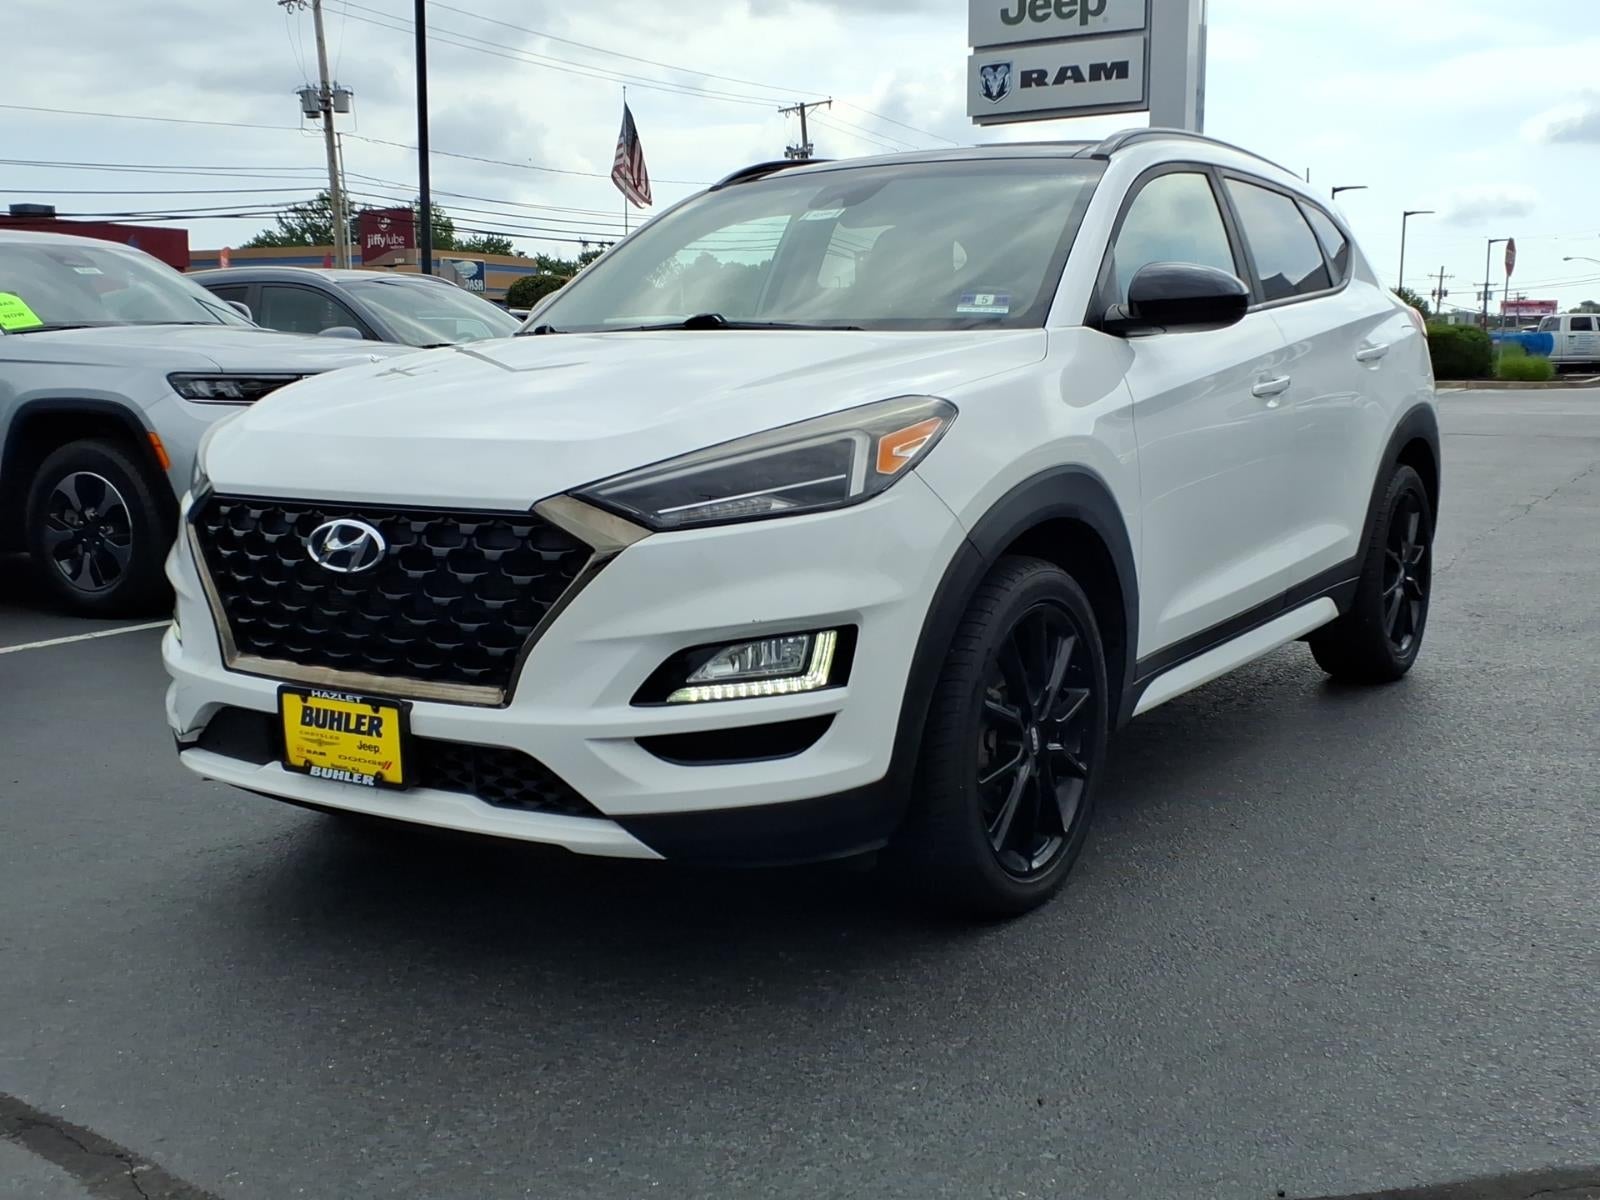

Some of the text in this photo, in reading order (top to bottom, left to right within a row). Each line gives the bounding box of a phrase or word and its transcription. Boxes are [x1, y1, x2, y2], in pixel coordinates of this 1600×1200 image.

[1000, 0, 1107, 26] Jeep
[1019, 60, 1129, 89] RAM
[367, 233, 405, 249] jiffy lube
[311, 691, 363, 703] HAZLET
[301, 706, 383, 738] BUHLER
[357, 740, 380, 755] Jeep
[310, 767, 375, 786] BUHLER
